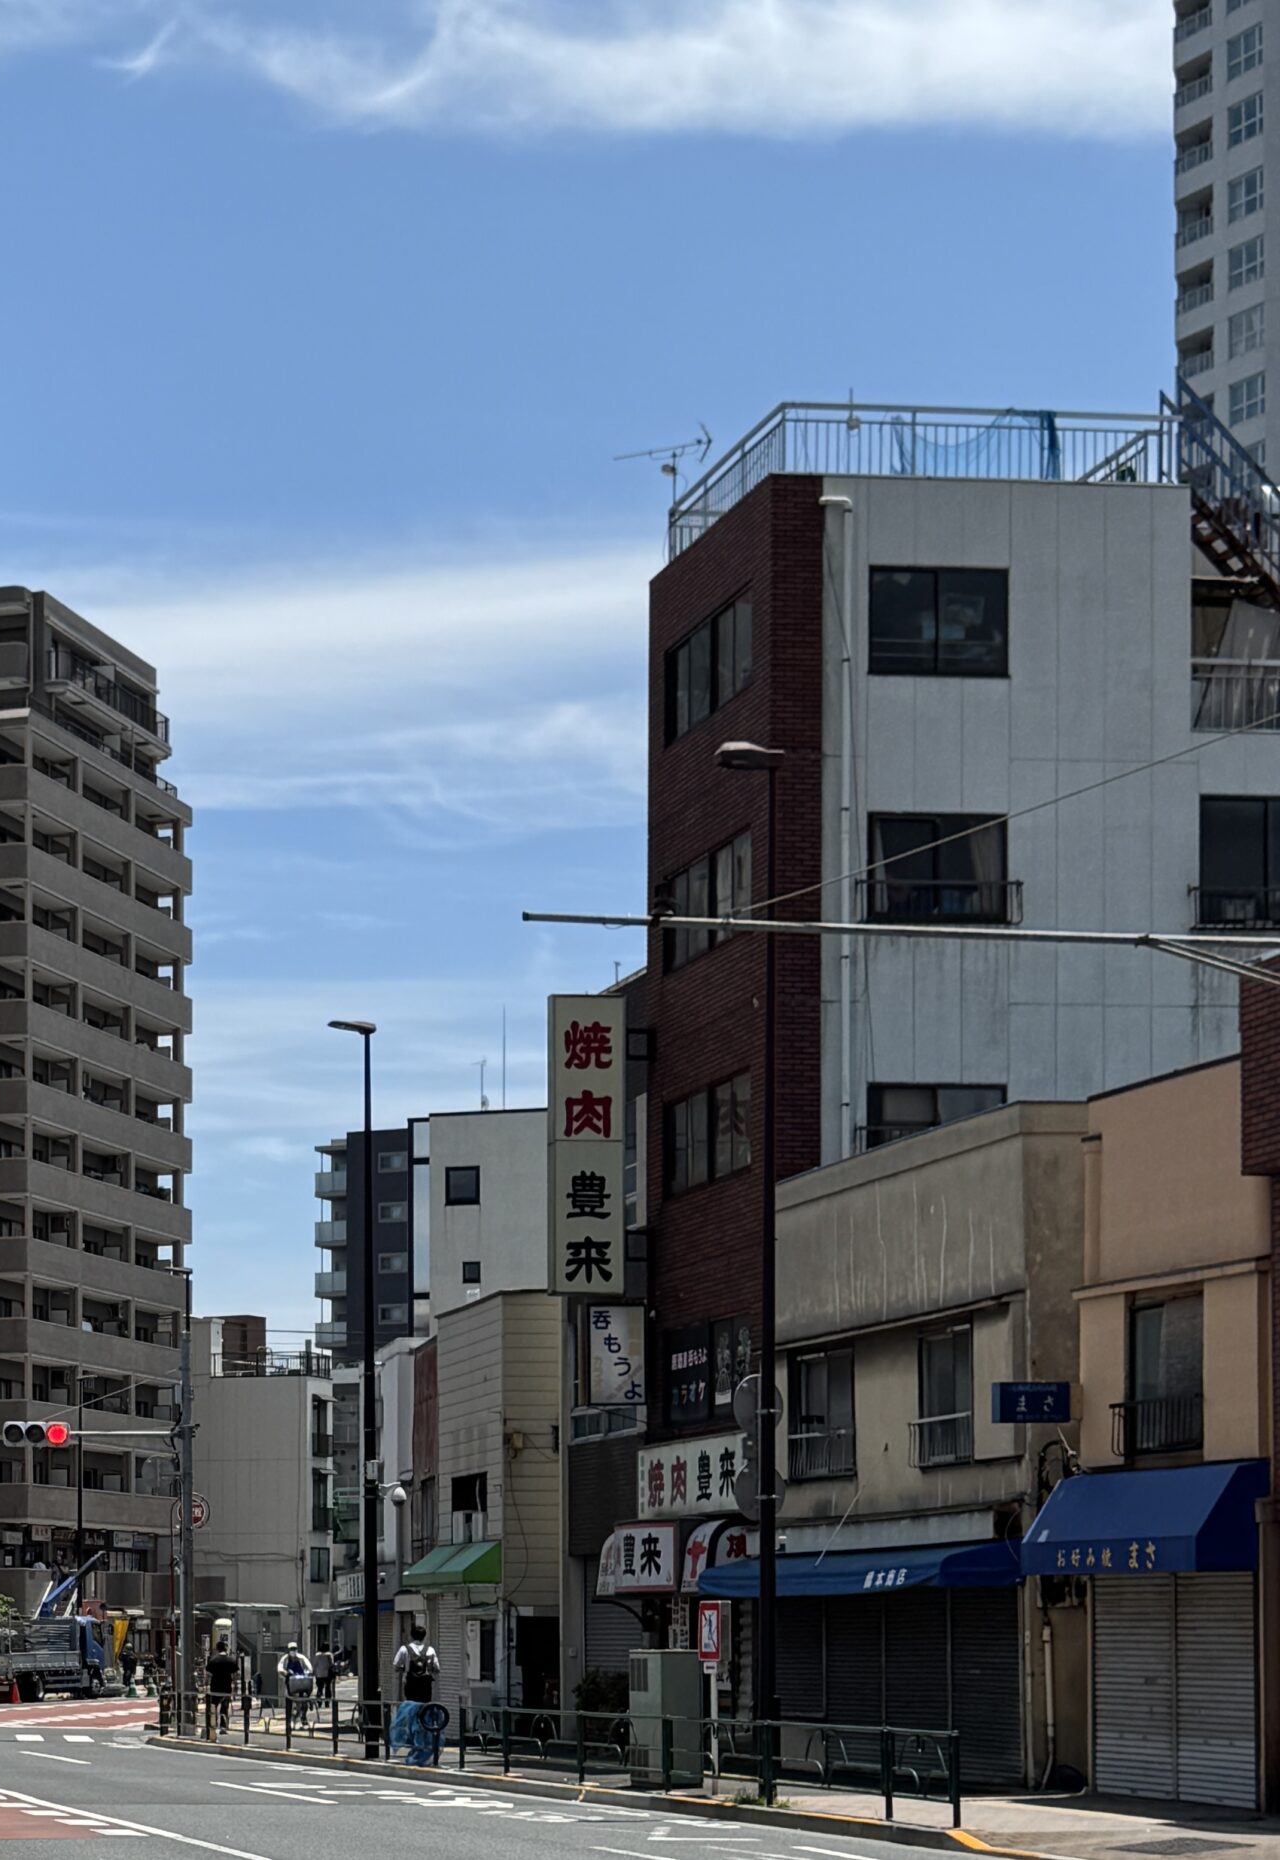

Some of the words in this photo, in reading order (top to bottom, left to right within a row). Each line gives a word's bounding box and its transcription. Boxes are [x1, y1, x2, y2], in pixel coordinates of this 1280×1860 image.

[564, 1020, 613, 1284] 焼肉豊来
[592, 1310, 642, 1400] 呑もうよ
[1016, 1394, 1054, 1412] まさ
[648, 1447, 736, 1509] 焼肉豊来
[623, 1532, 662, 1577] 豊来
[1057, 1547, 1112, 1568] お好み焼
[1128, 1541, 1156, 1569] まさ
